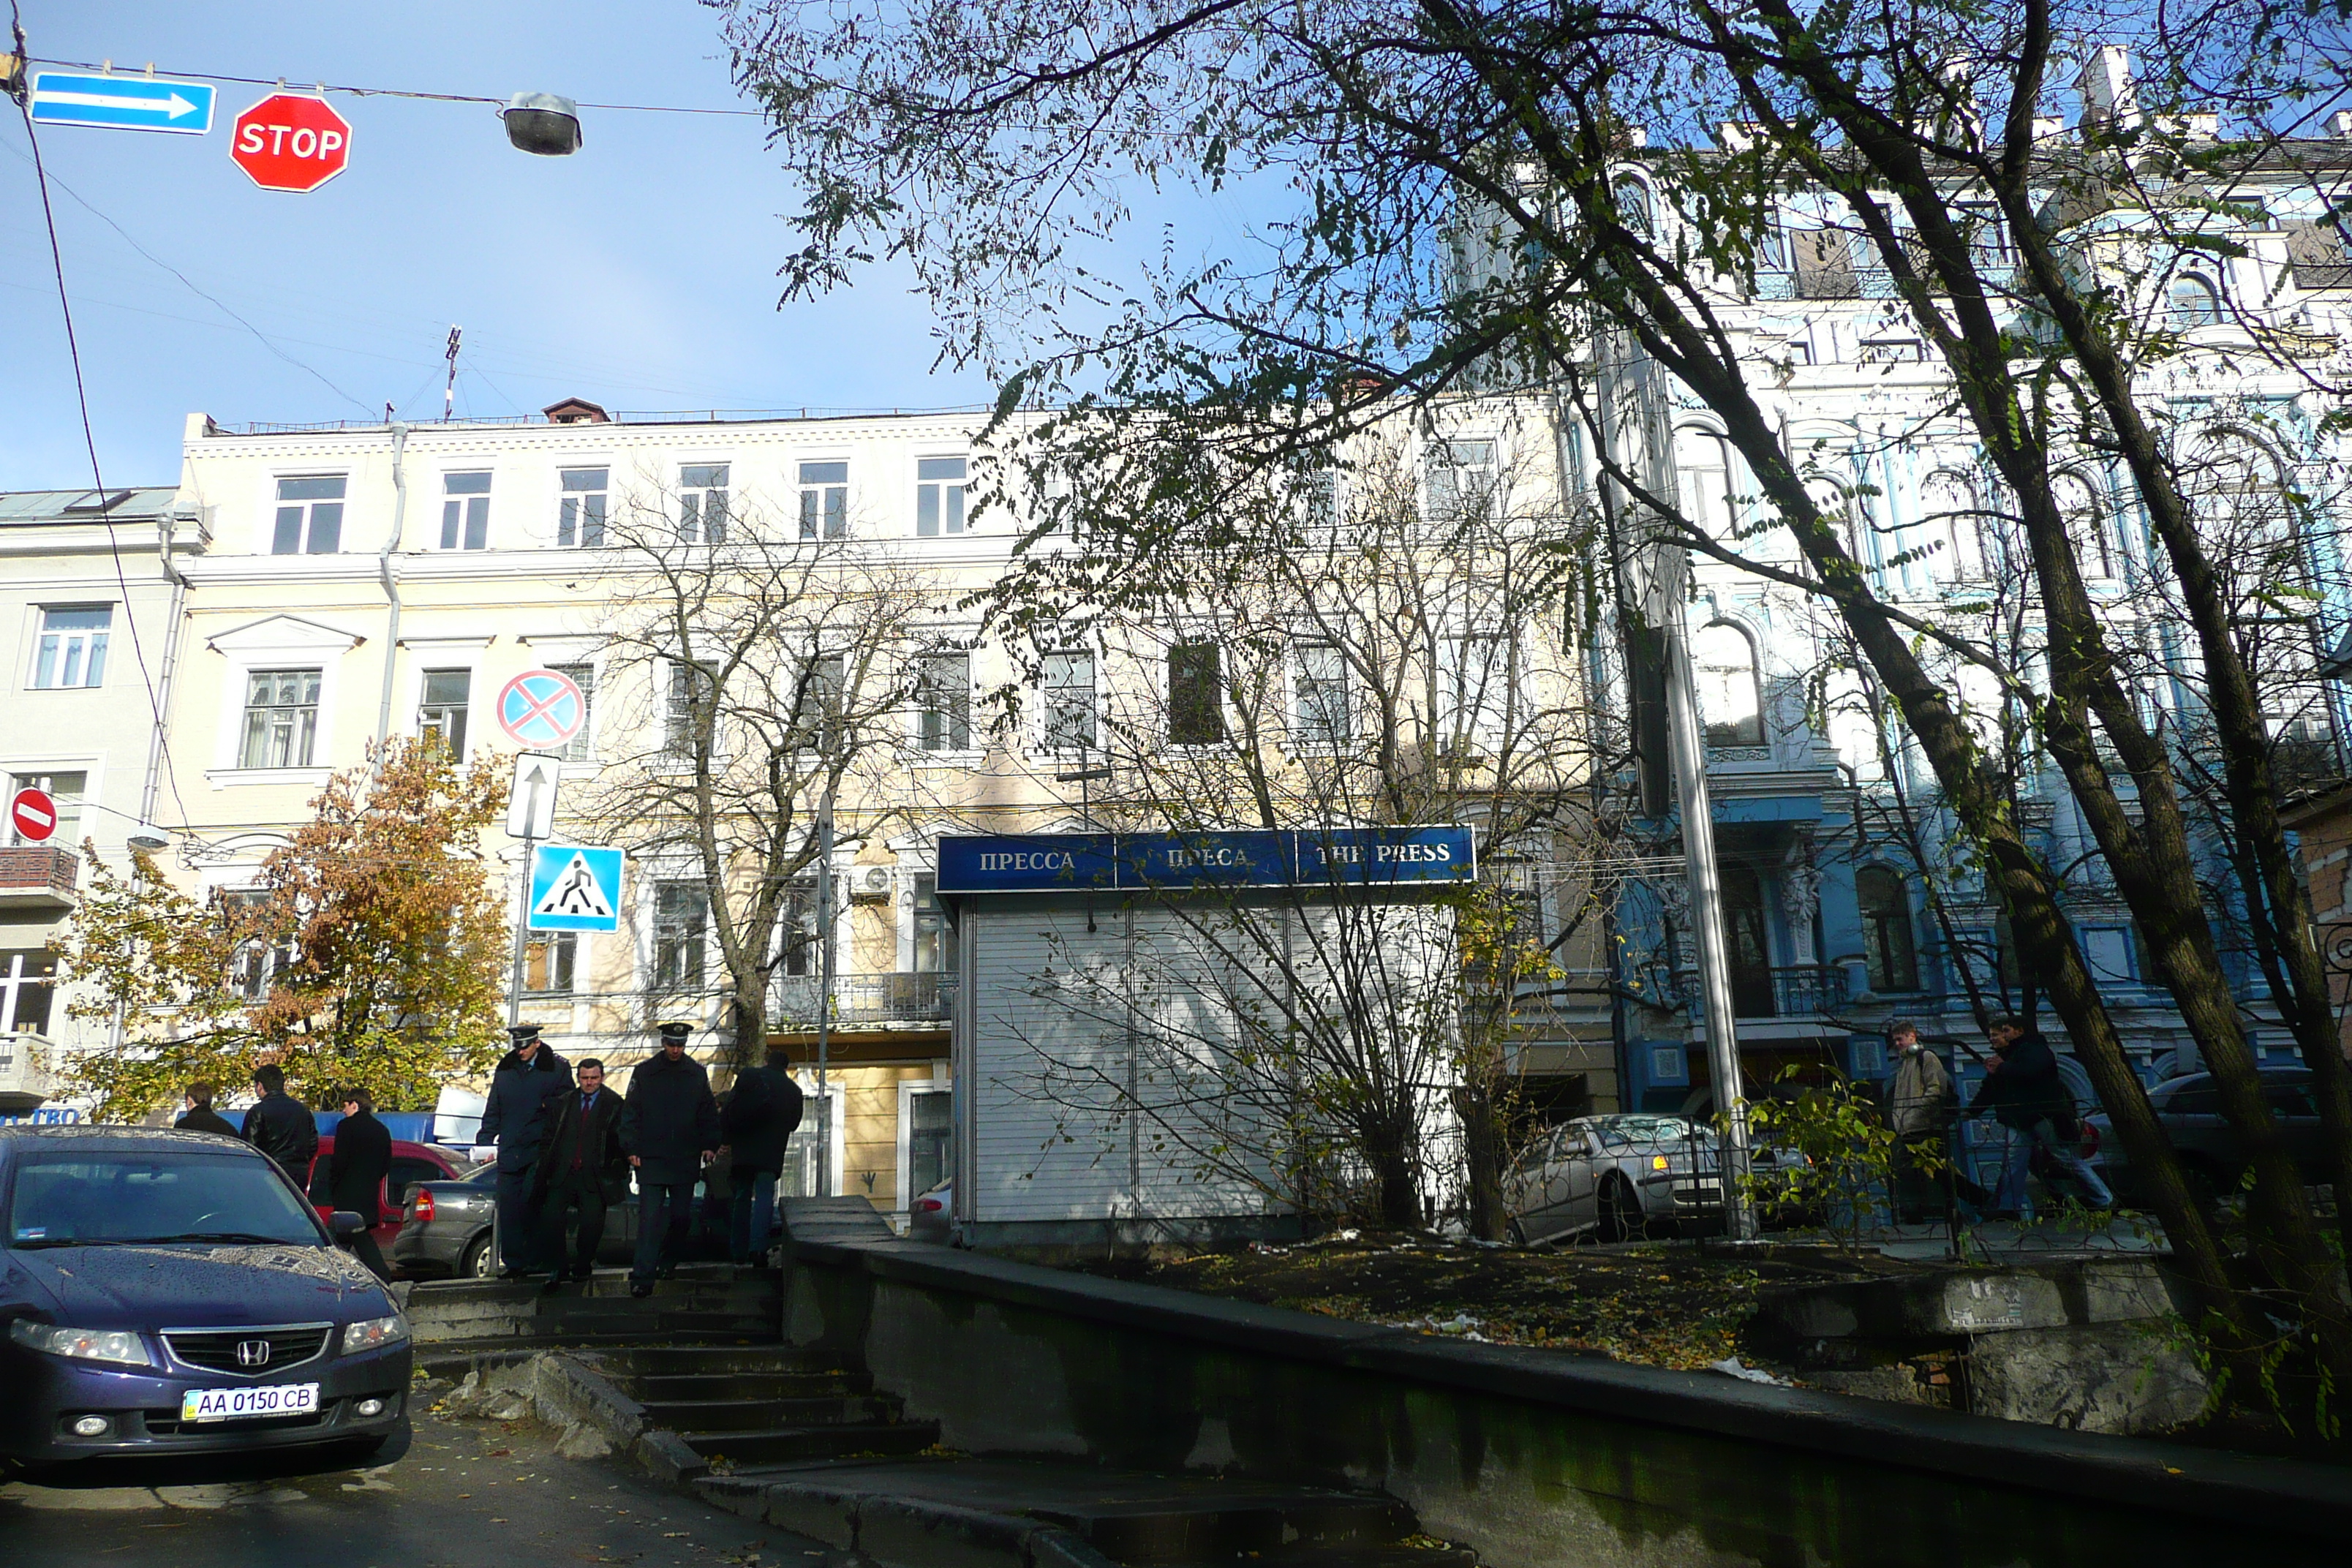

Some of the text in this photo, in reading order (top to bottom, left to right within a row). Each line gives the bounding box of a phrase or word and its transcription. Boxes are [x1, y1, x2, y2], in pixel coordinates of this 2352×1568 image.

[238, 123, 343, 160] STOP
[979, 851, 1076, 871] ПРЕССА
[1166, 848, 1248, 867] ПРЕСА
[1376, 843, 1451, 863] PRESS
[198, 1389, 310, 1414] AA 0150 CB
